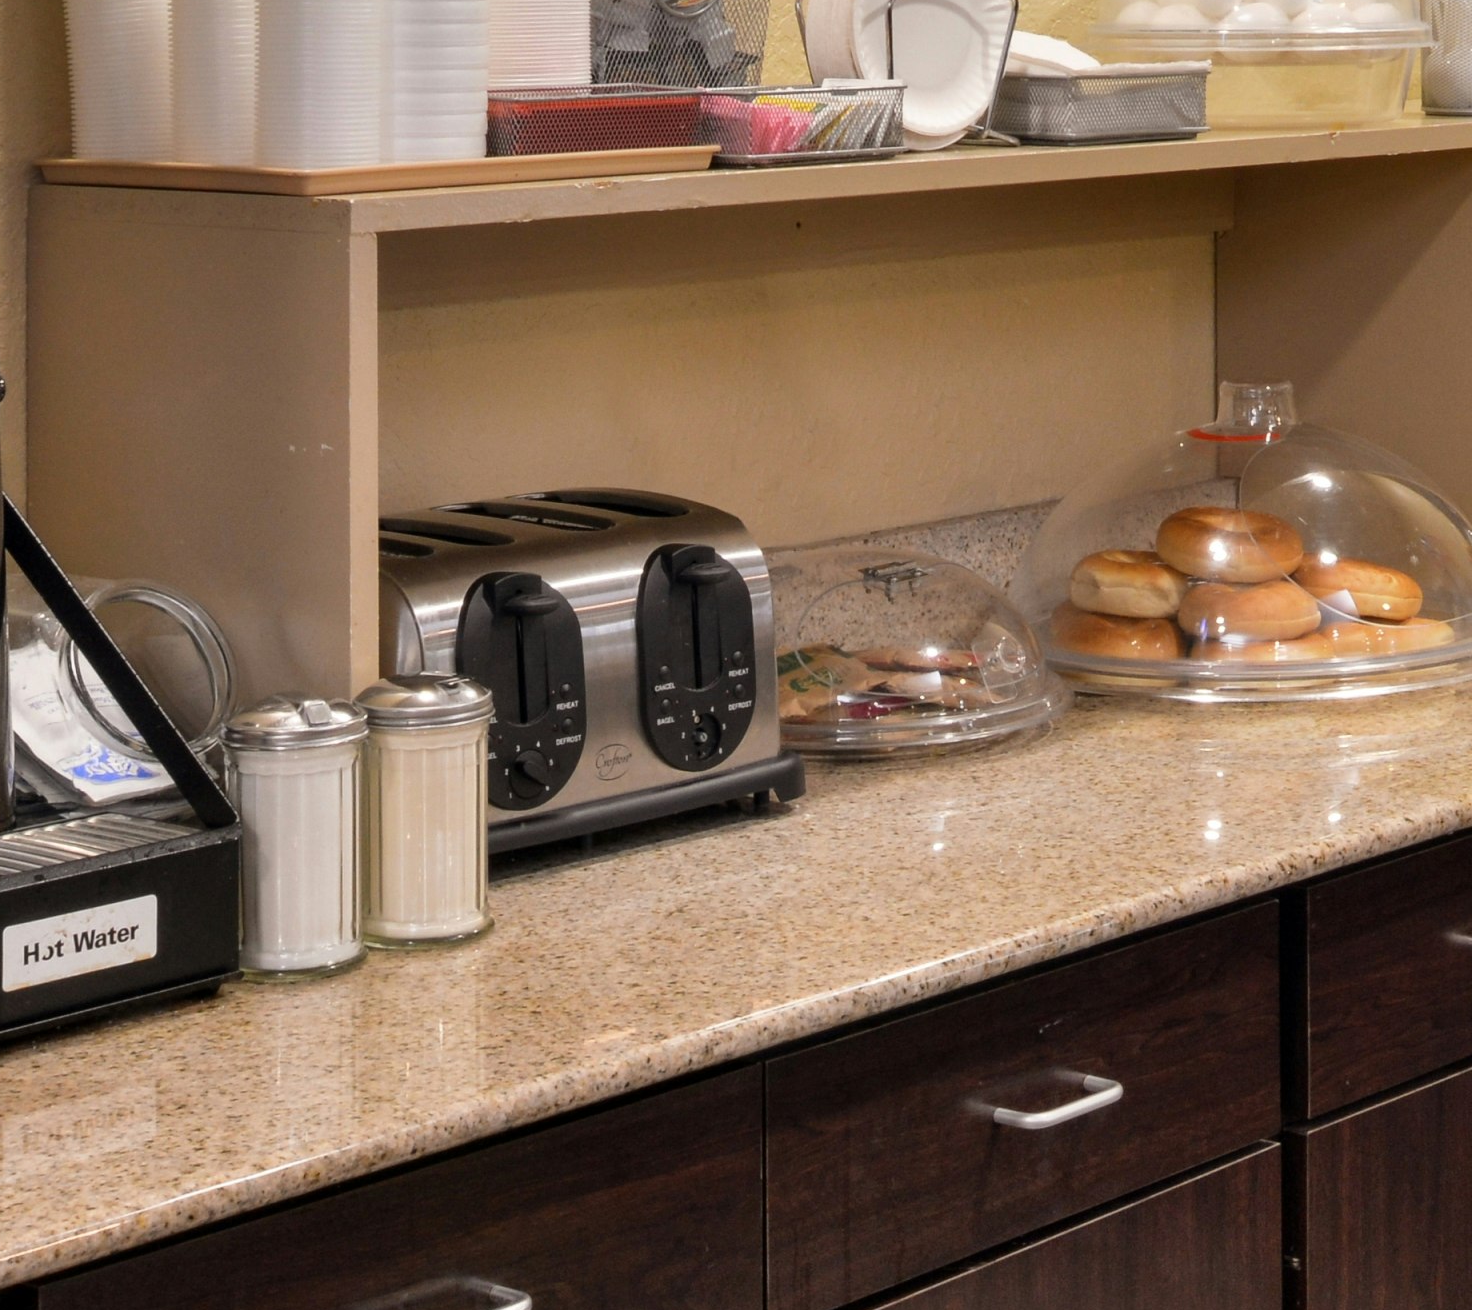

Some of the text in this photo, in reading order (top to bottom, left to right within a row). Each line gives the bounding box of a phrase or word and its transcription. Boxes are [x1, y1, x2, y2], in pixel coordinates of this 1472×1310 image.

[556, 700, 579, 711] REHEAT
[555, 734, 582, 746] DEFROST
[23, 924, 140, 966] Hot Water
